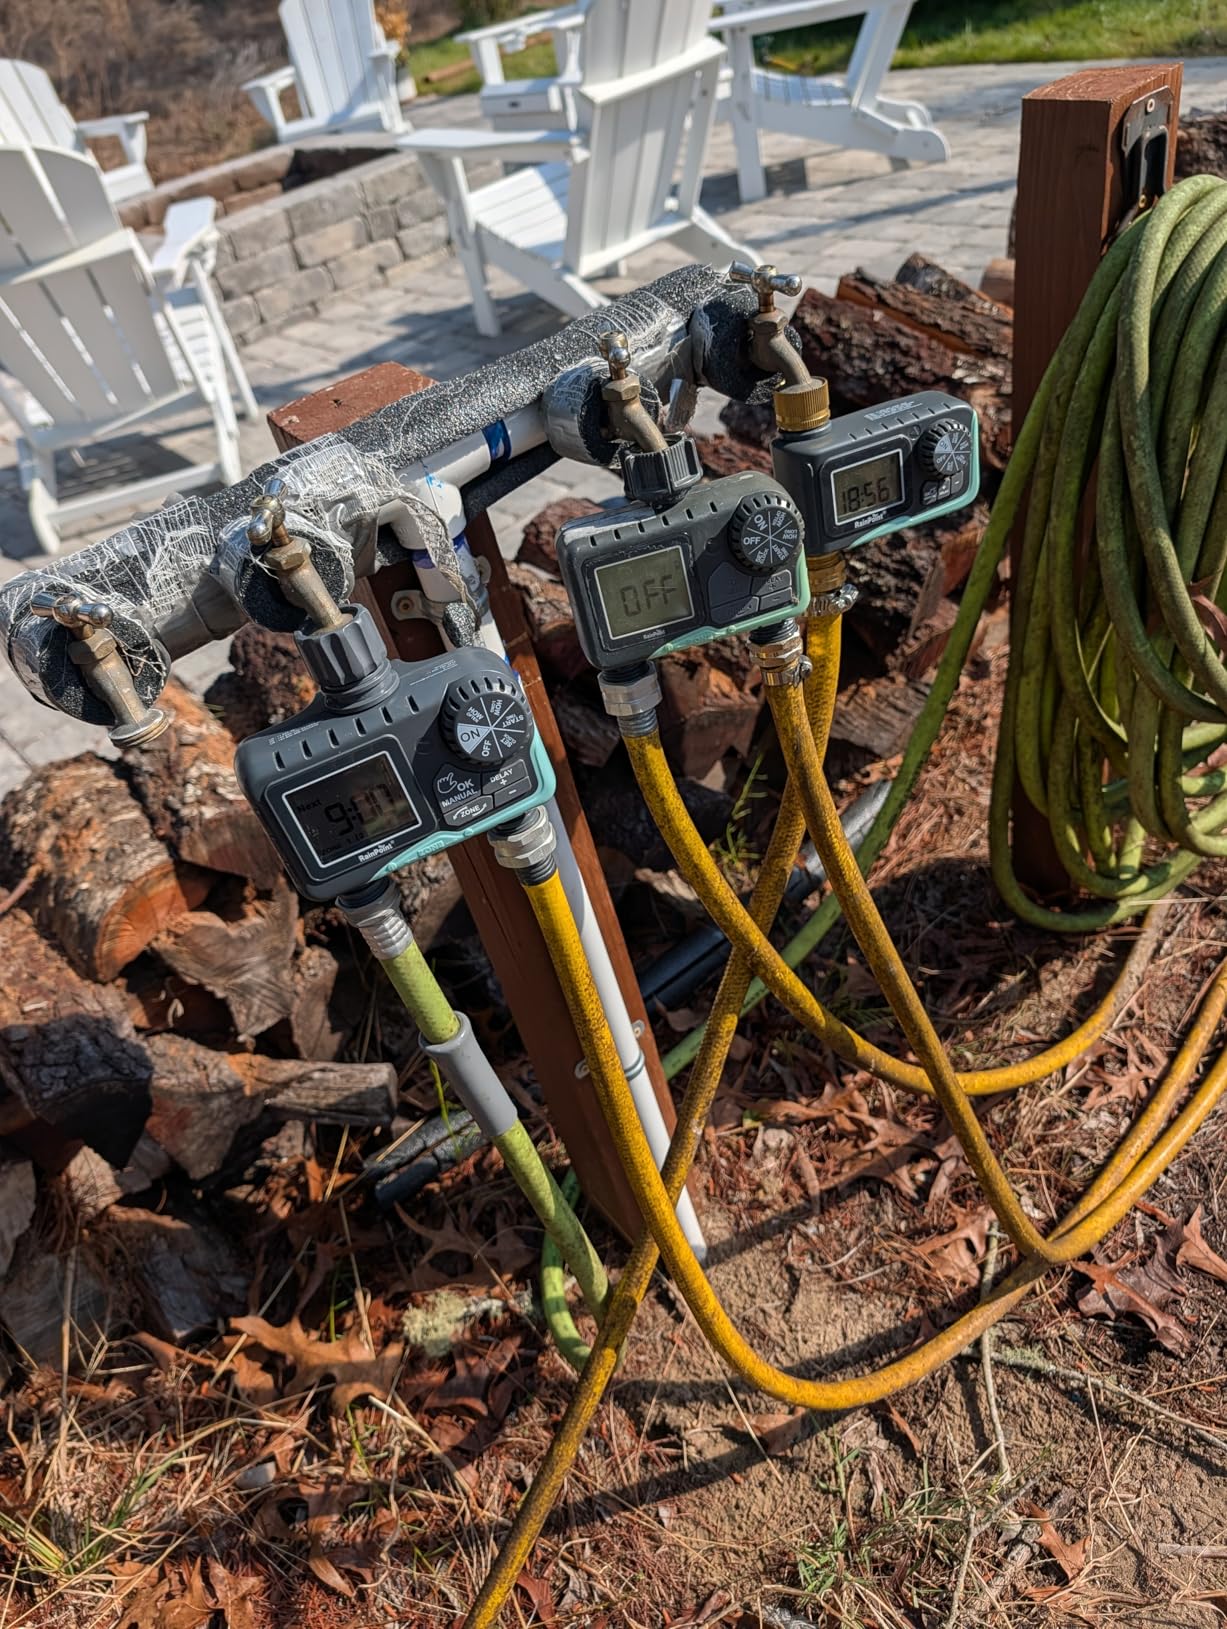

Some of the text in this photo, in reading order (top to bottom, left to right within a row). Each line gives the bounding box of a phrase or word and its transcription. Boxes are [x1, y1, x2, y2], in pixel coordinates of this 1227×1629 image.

[842, 477, 890, 514] 18:56
[754, 514, 768, 531] ON
[743, 536, 761, 545] OFF
[772, 544, 786, 561] START
[620, 575, 676, 617] OFF
[468, 706, 484, 721] HOW
[493, 699, 503, 716] HOW
[502, 714, 525, 728] START
[460, 728, 481, 743] ON
[481, 740, 492, 757] OFF
[490, 768, 513, 783] DELAY
[457, 778, 474, 792] OK
[441, 788, 478, 808] MANUAL
[460, 804, 481, 818] ZONE
[358, 842, 393, 863] RainPoint
